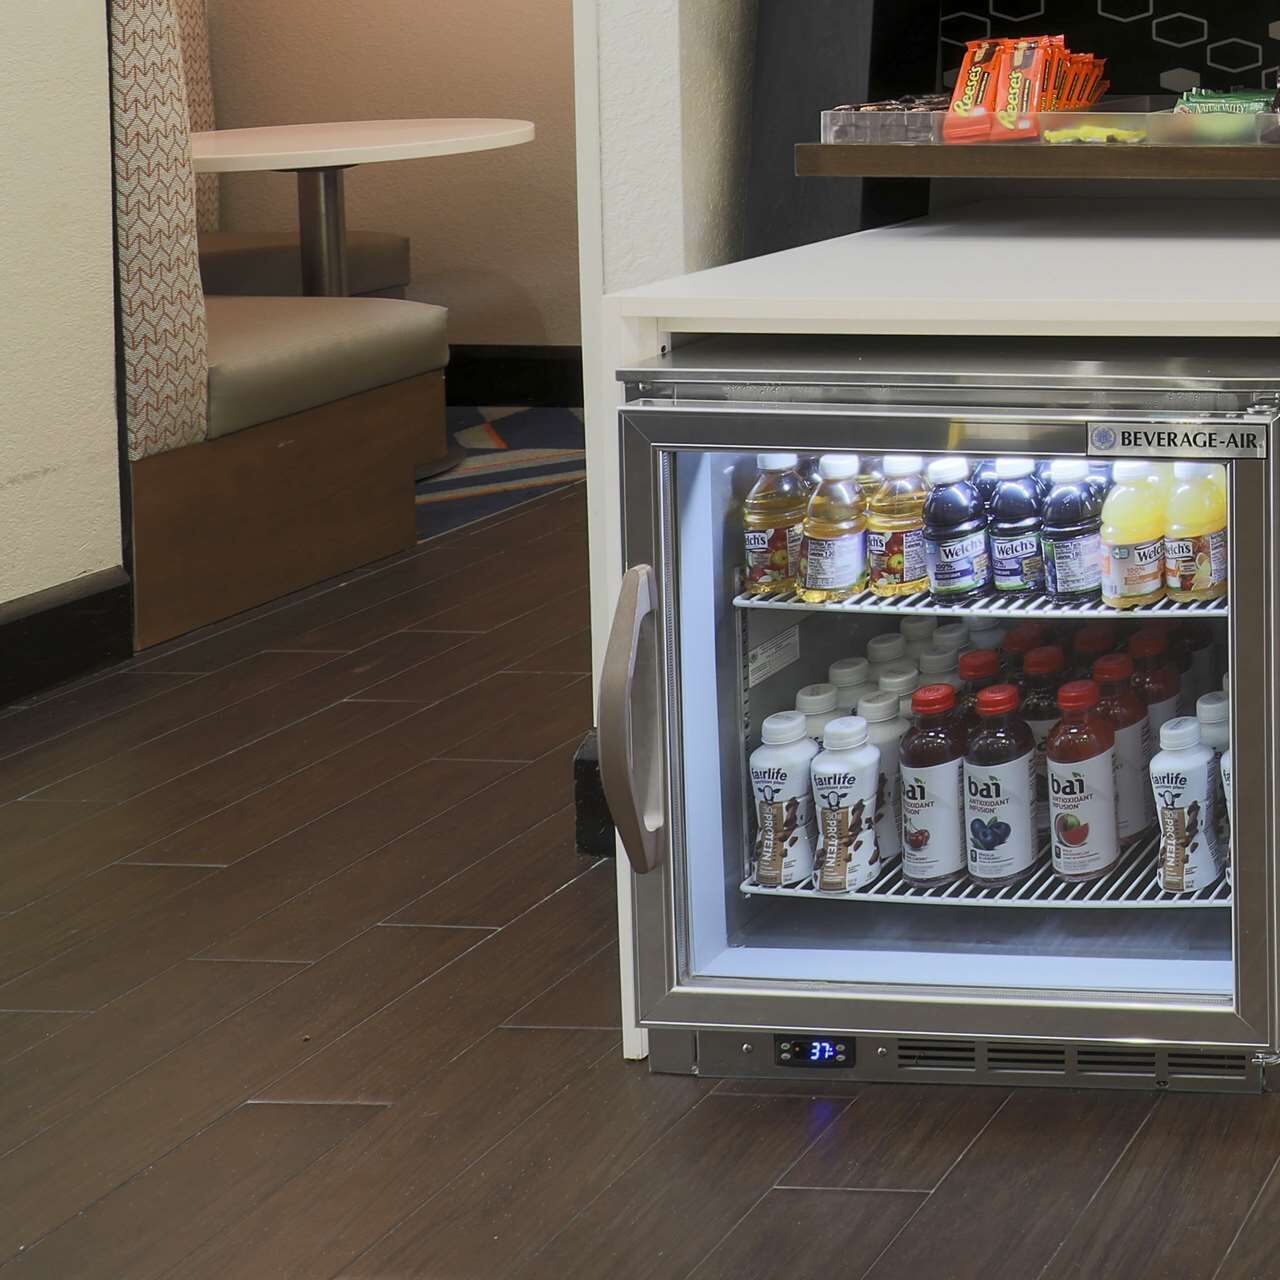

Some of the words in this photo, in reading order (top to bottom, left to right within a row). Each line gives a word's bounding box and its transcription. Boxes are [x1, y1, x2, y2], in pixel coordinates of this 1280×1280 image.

[1121, 430, 1258, 449] BEVERAGE-AIR
[996, 542, 1036, 557] Welch's
[752, 768, 788, 781] fairlife
[814, 772, 857, 786] fairlife
[968, 775, 1001, 799] bai
[1050, 773, 1085, 796] bai
[969, 798, 1010, 807] ANTIOXIDANT
[1052, 793, 1094, 804] ANTIOXIDANT
[763, 814, 774, 858] PROTEIN
[827, 819, 837, 868] PROTEIN
[1166, 818, 1176, 868] PROTEIN
[809, 1041, 830, 1061] 37
